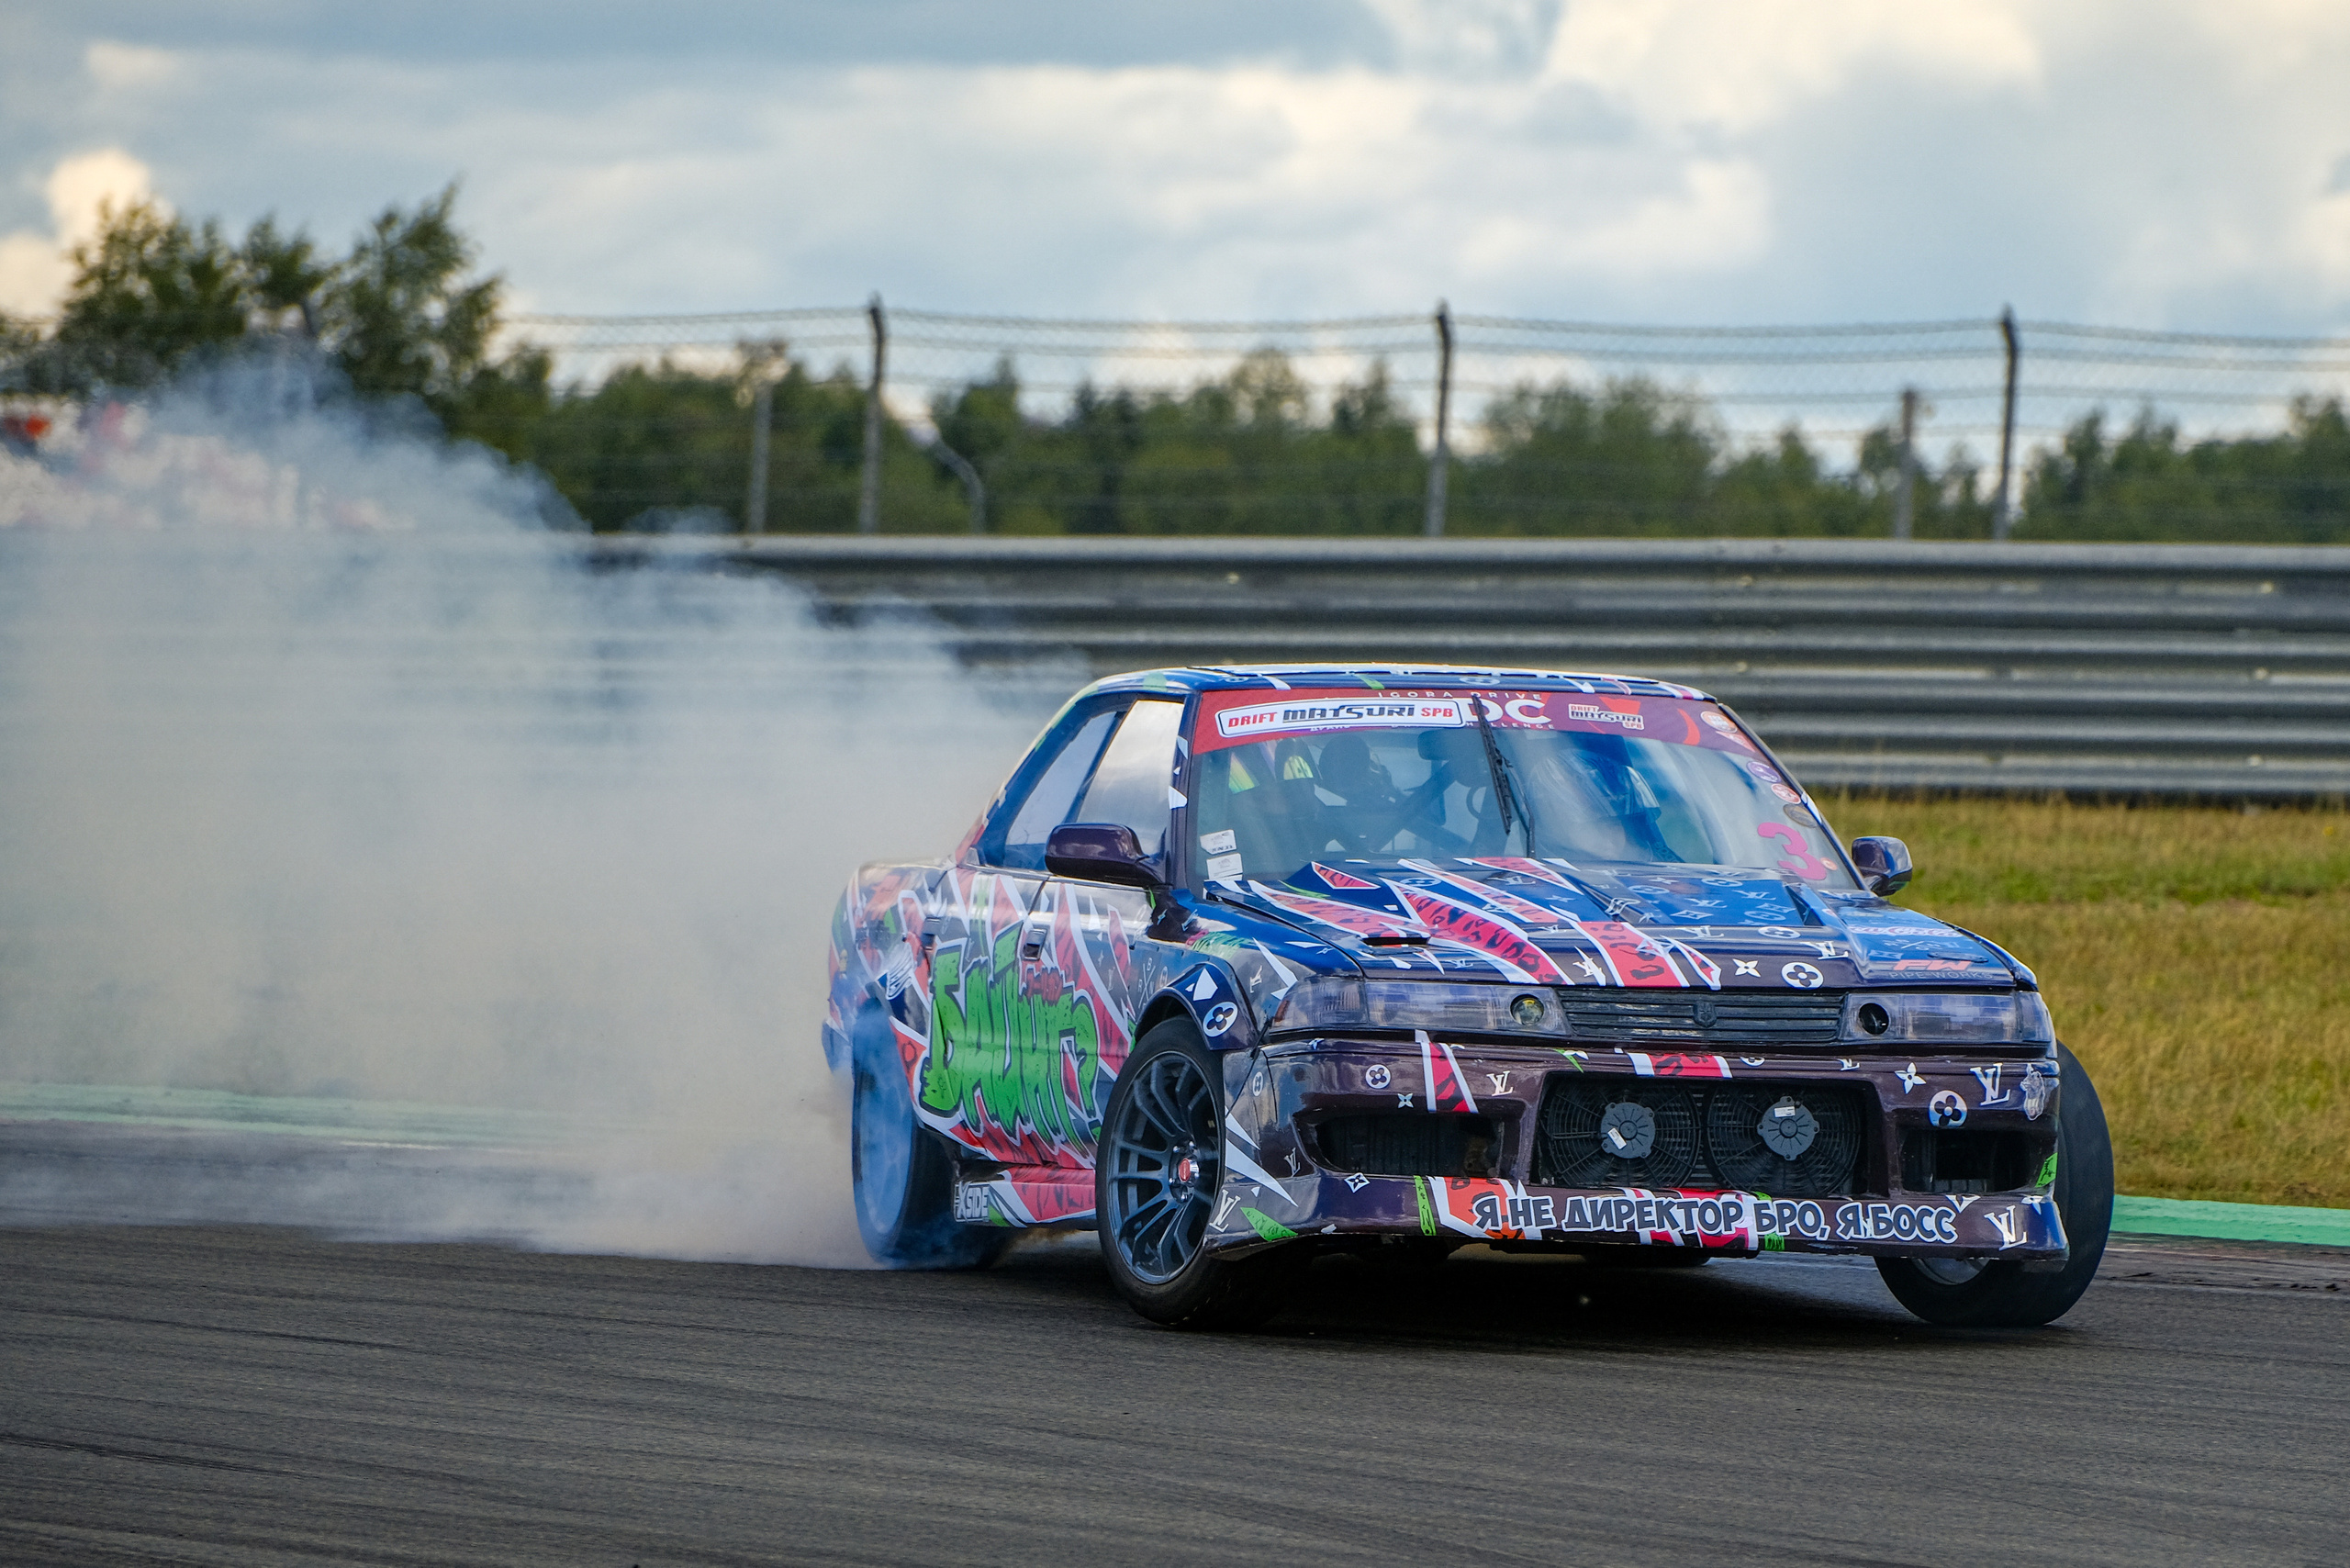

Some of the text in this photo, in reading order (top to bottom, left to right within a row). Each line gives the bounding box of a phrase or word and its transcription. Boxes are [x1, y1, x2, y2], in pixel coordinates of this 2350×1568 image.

[1471, 691, 1542, 700] DRIVE
[1227, 711, 1278, 728] DRIFT
[1420, 707, 1454, 718] SPB
[1757, 822, 1827, 880] 3
[1888, 971, 1994, 980] PIPE WORKS
[1473, 1196, 1957, 1243] Я НЕ ДИРЕКТОР БРО, Я БОСС
